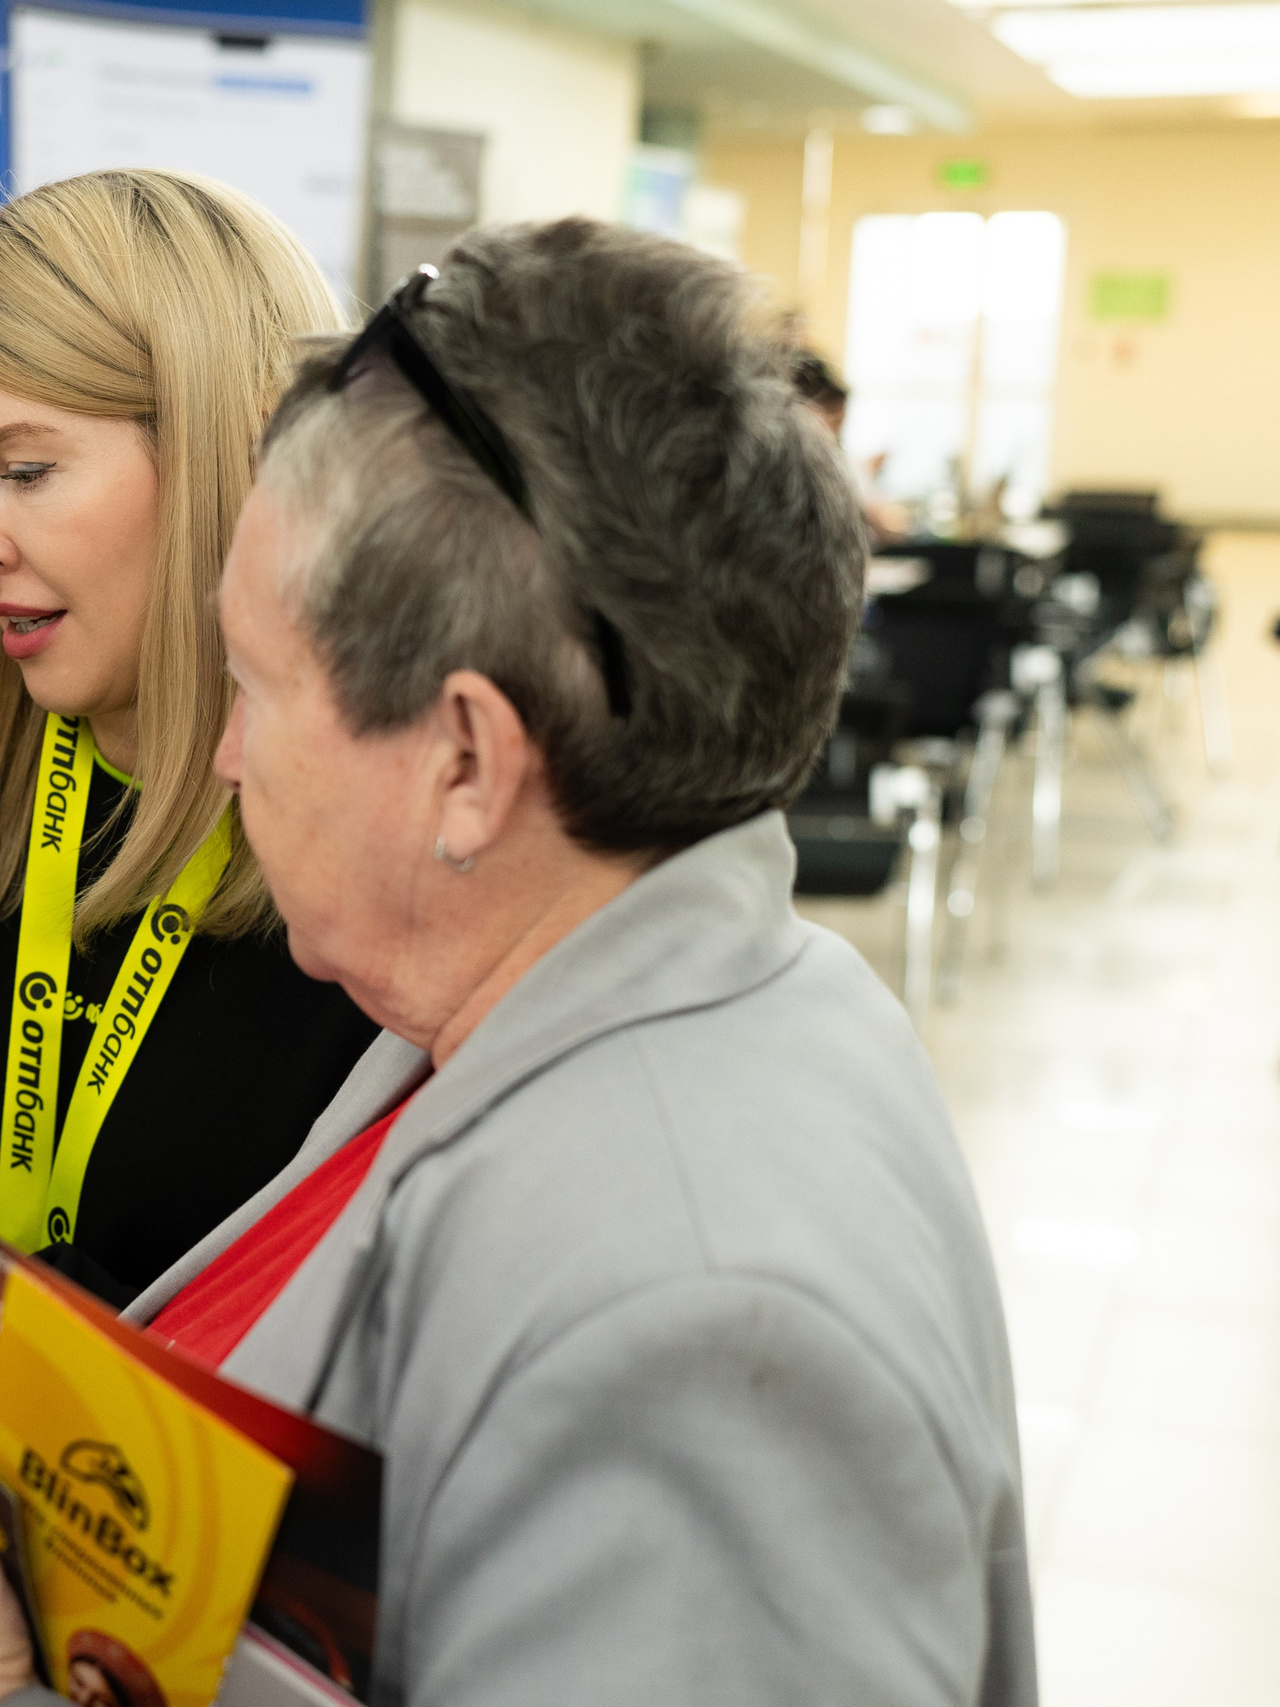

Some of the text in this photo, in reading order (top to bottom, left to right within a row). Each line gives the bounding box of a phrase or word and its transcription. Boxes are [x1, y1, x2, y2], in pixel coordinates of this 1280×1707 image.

[10, 1020, 45, 1173] отпбанк
[87, 947, 163, 1096] отпбанк
[18, 1447, 174, 1599] BlinBox
